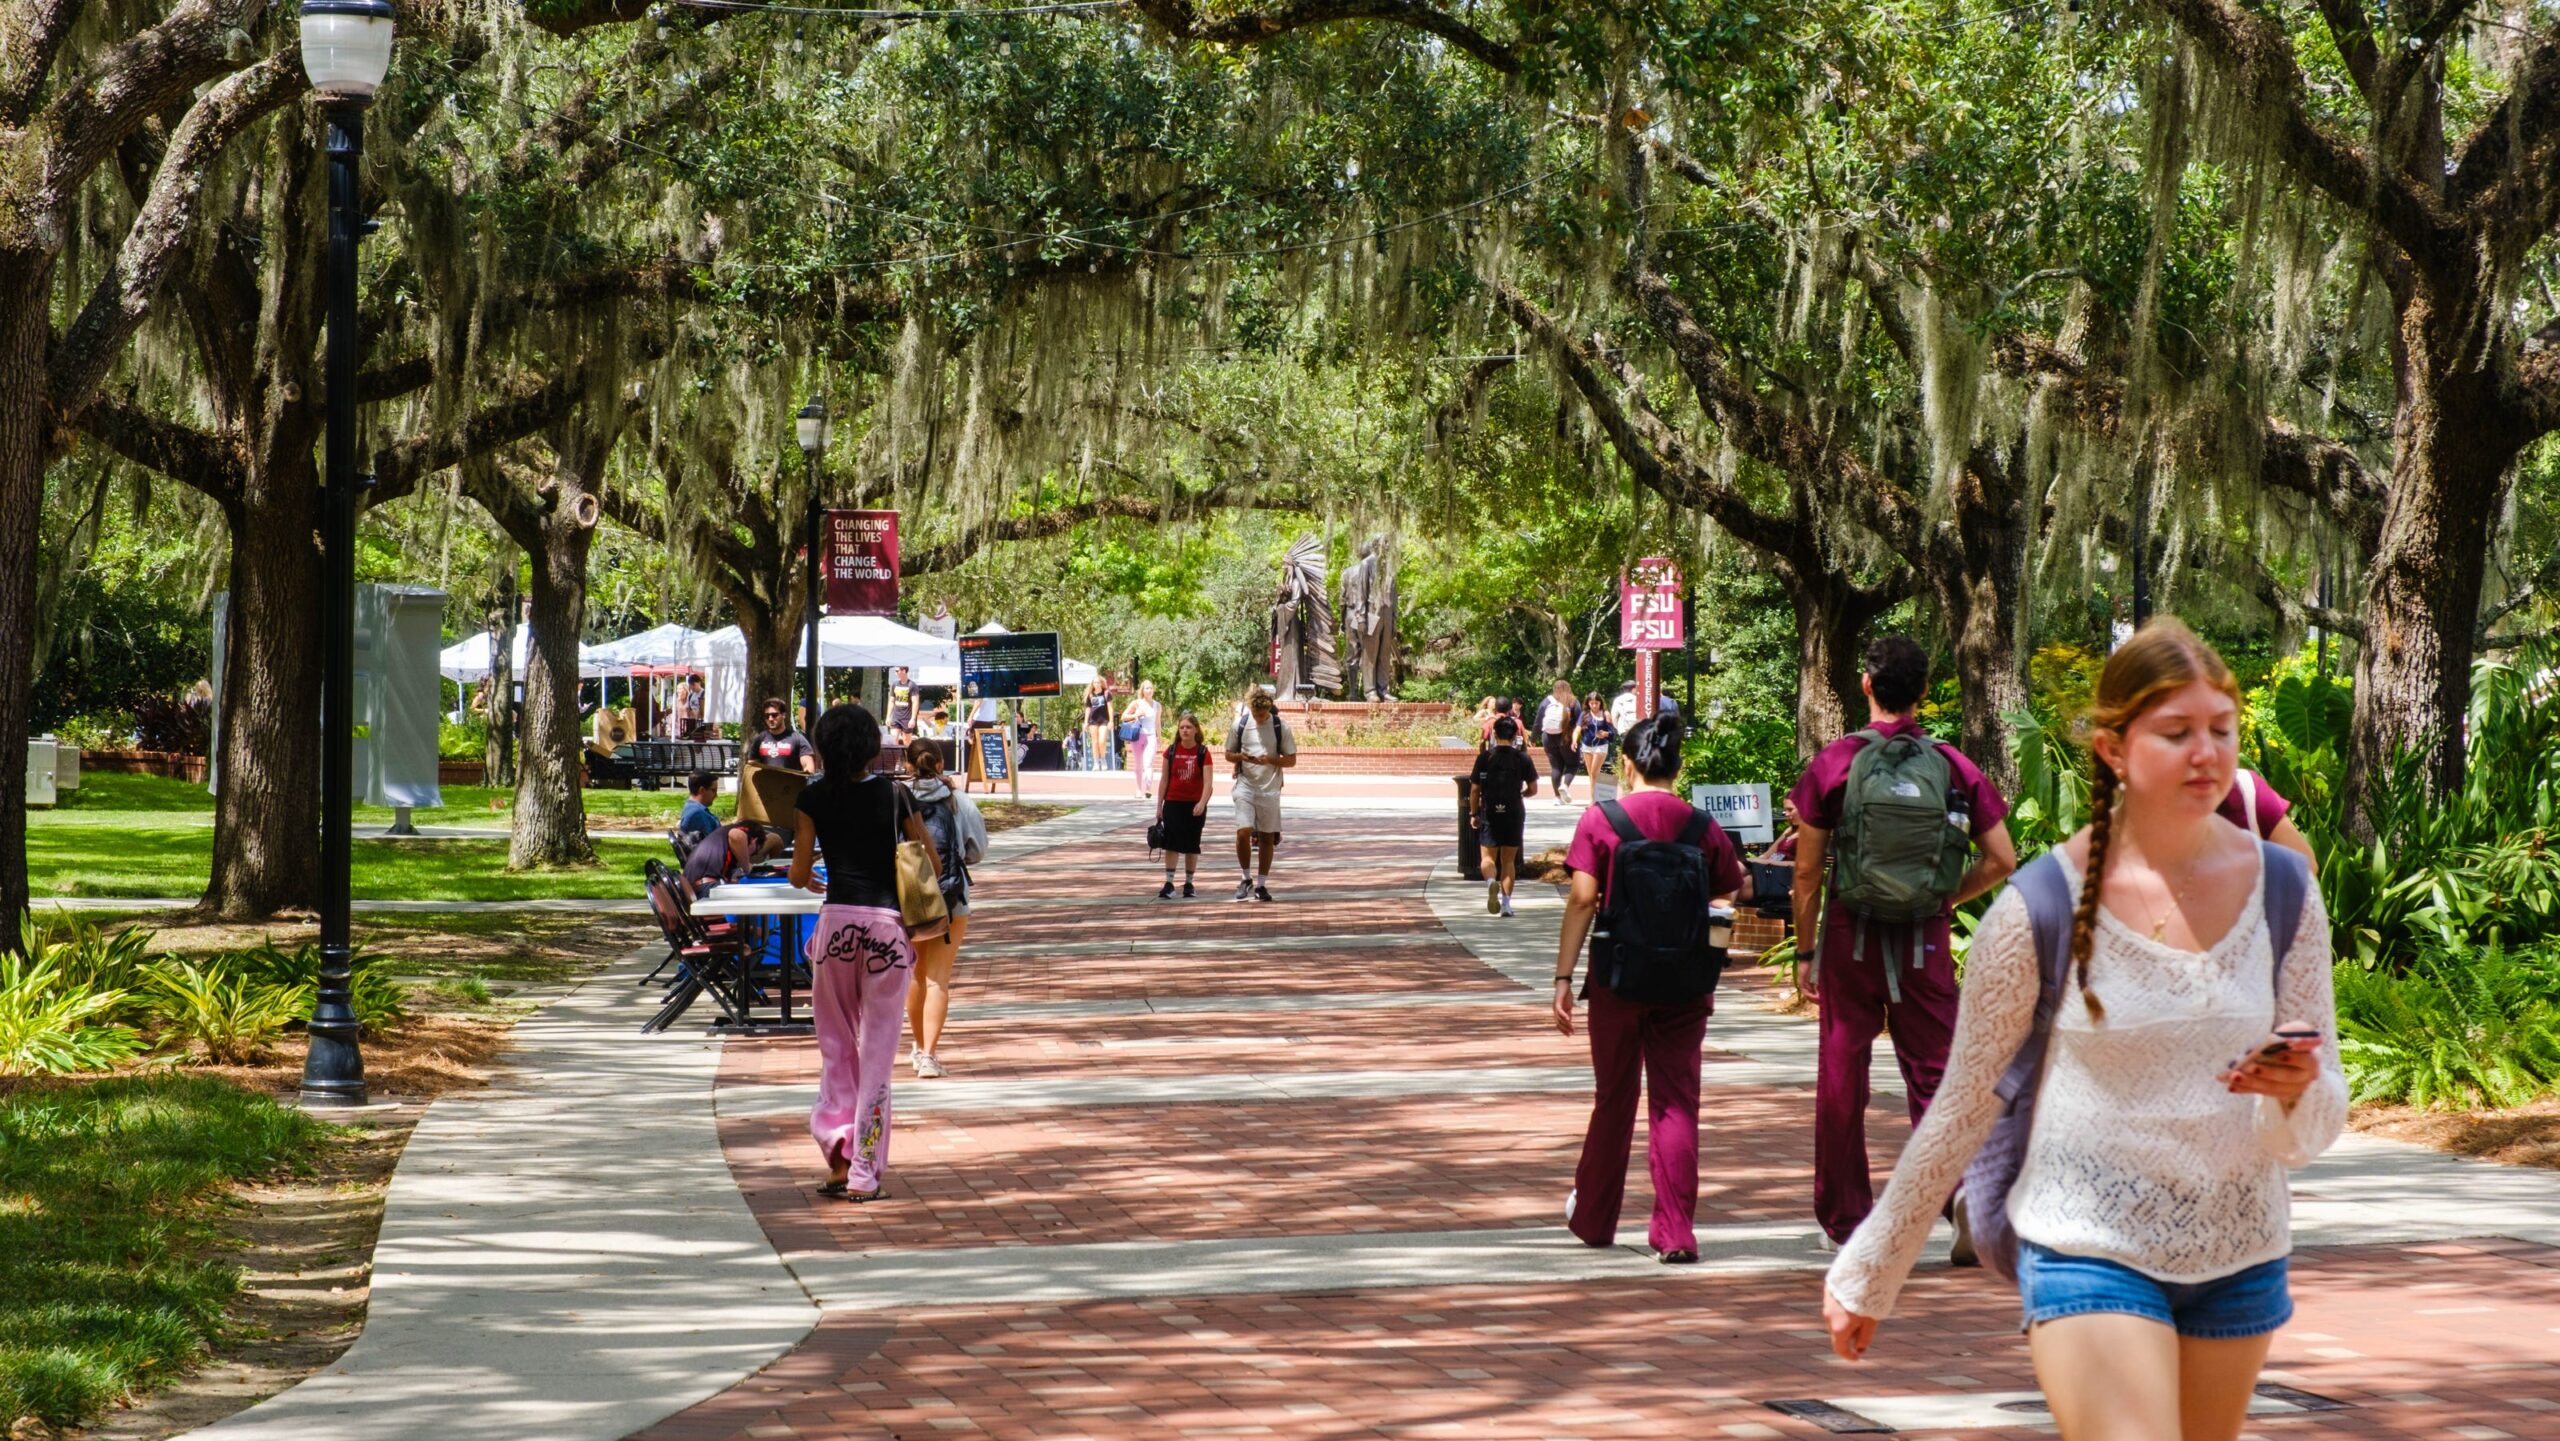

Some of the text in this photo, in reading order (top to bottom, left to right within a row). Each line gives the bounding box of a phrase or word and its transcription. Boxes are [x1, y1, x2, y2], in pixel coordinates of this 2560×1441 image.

[834, 519, 889, 531] CHANGING
[834, 531, 882, 543] THE LIVES
[834, 543, 860, 554] THAT
[834, 556, 877, 567] CHANGE
[834, 568, 892, 579] THE WORLD
[1630, 593, 1674, 613] FSU
[1630, 620, 1675, 640] FSU
[1644, 650, 1653, 719] EMERGENCY
[1705, 795, 1760, 812] ELEMENT3
